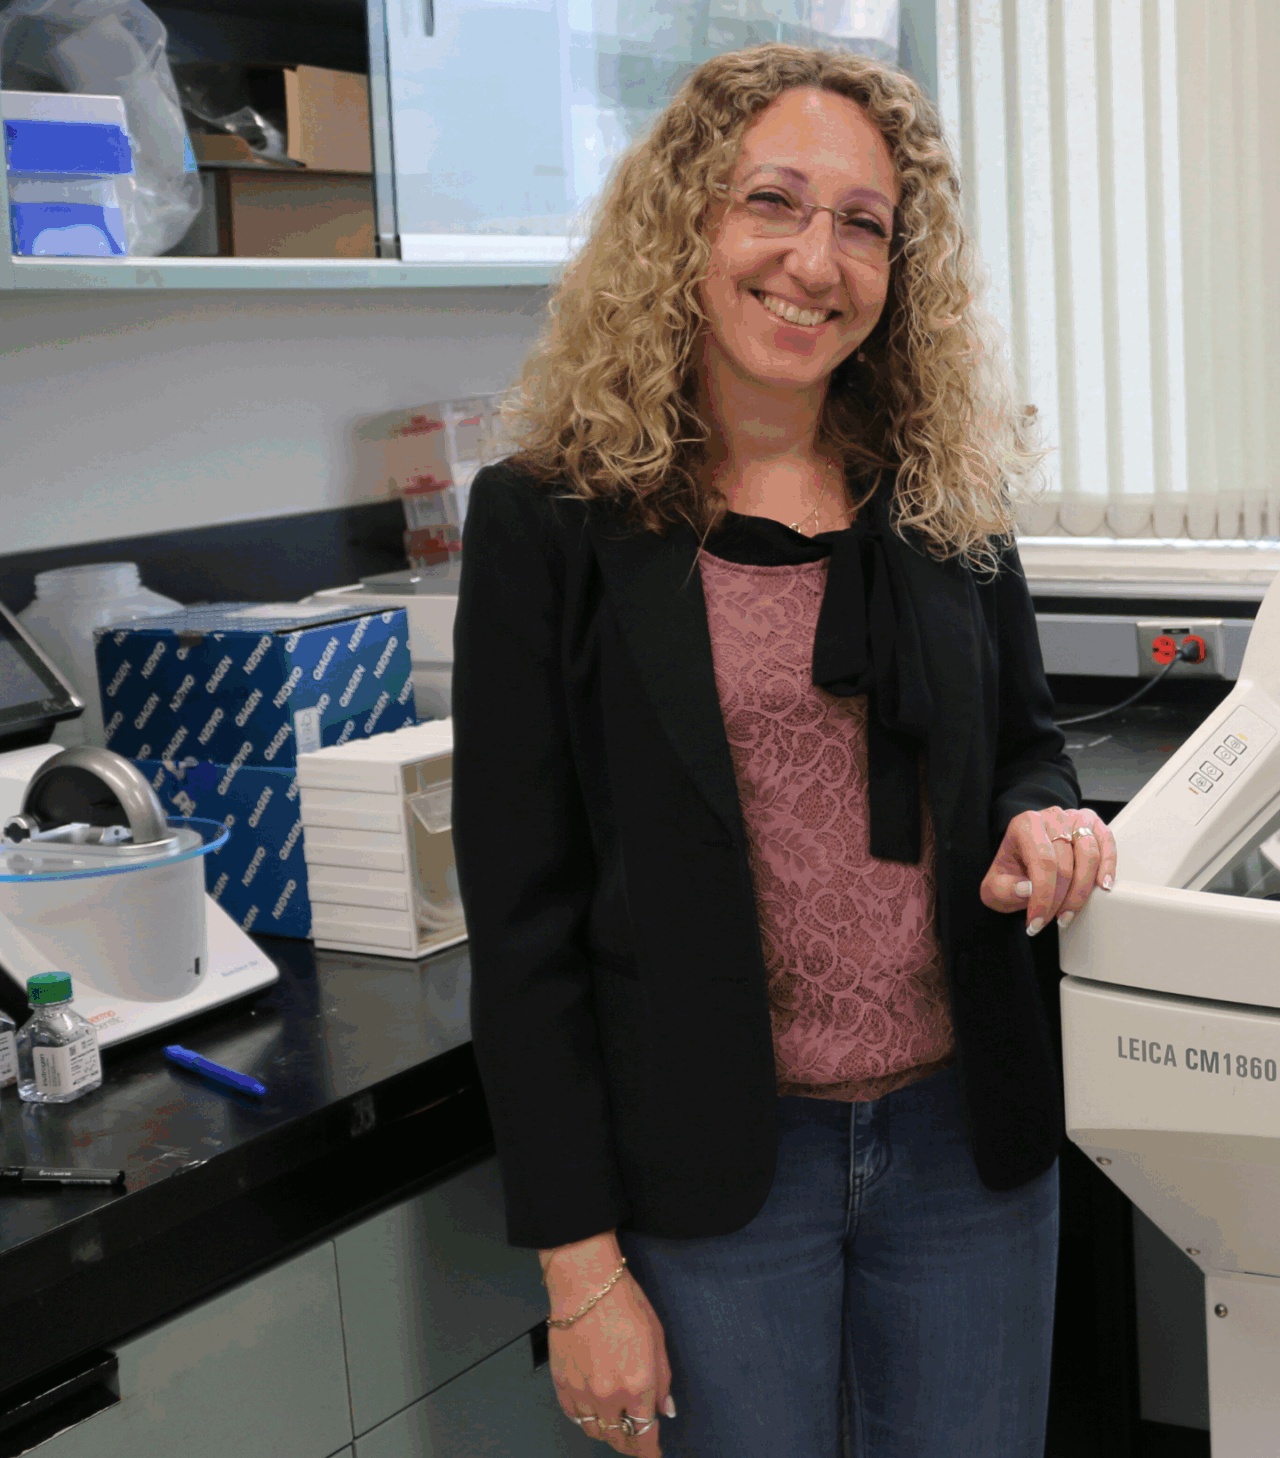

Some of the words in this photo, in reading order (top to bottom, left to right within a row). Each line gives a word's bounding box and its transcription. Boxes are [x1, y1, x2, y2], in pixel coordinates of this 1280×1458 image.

[141, 641, 166, 679] QIAGEN
[205, 655, 233, 693] QIAGEN
[243, 635, 273, 675] QIAGEN
[313, 636, 339, 680] QIAGEN
[373, 636, 398, 679] QIAGEN
[106, 659, 132, 697] QIAGEN
[169, 674, 194, 712] QIAGEN
[273, 666, 303, 709] QIAGEN
[339, 664, 366, 707] QIAGEN
[134, 692, 160, 729] QIAGEN
[198, 707, 223, 745] QIAGEN
[235, 688, 263, 727] QIAGEN
[364, 690, 391, 733] QIAGEN
[264, 722, 292, 761] QIAGEN
[248, 786, 273, 828] QIAGEN
[242, 846, 266, 887] QIAGEN
[272, 879, 297, 921] QIAGEN
[1118, 1036, 1177, 1067] LEICA
[1185, 1047, 1277, 1082] CM1860
